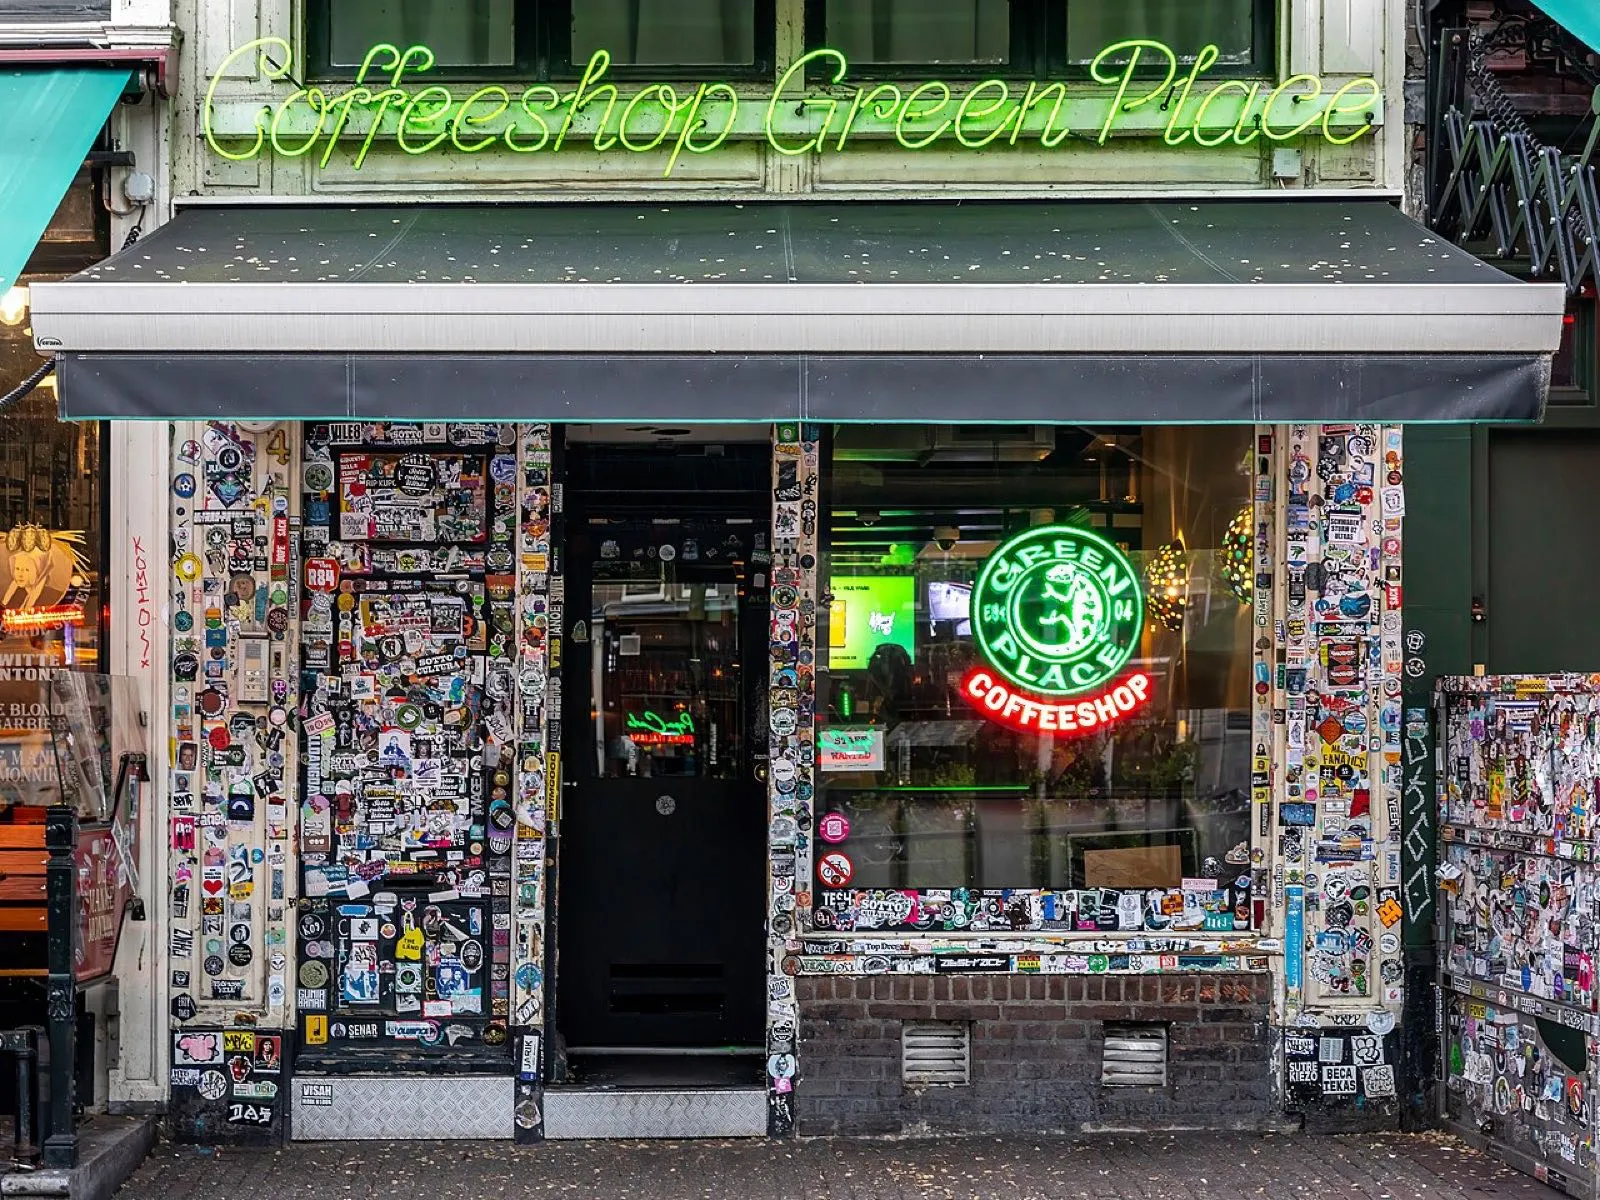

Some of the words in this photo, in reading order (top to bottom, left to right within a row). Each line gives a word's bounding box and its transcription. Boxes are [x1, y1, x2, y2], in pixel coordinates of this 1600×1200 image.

[203, 36, 739, 178] Coffeeshop
[765, 48, 1069, 154] Green
[1091, 39, 1382, 147] Place
[990, 540, 1132, 596] GREEN
[990, 630, 1125, 690] PLACE
[967, 673, 1149, 731] COFFEESHOP
[1327, 1068, 1353, 1078] BECA
